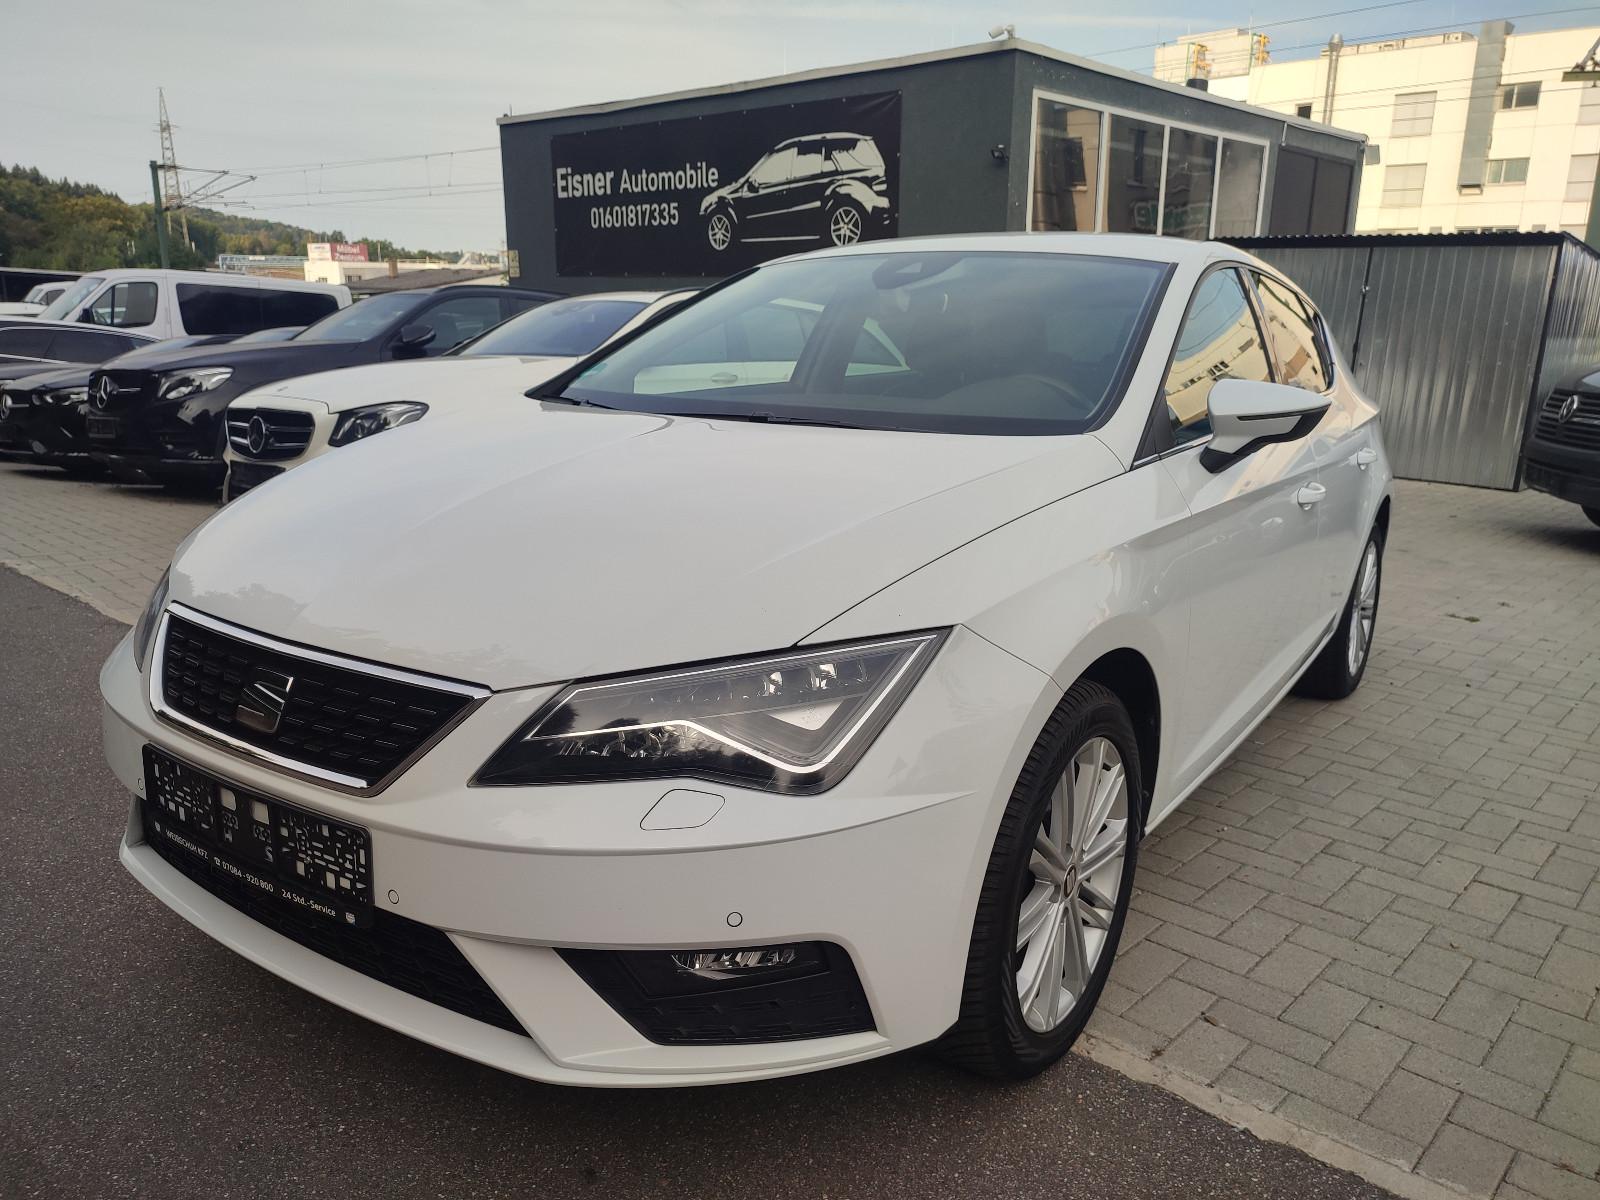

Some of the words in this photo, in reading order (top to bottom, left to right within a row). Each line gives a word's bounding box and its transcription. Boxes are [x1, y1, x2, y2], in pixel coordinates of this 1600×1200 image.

[556, 166, 615, 199] Eisner
[619, 161, 719, 194] Automobile
[590, 202, 679, 229] 01601817335
[281, 888, 292, 900] 24
